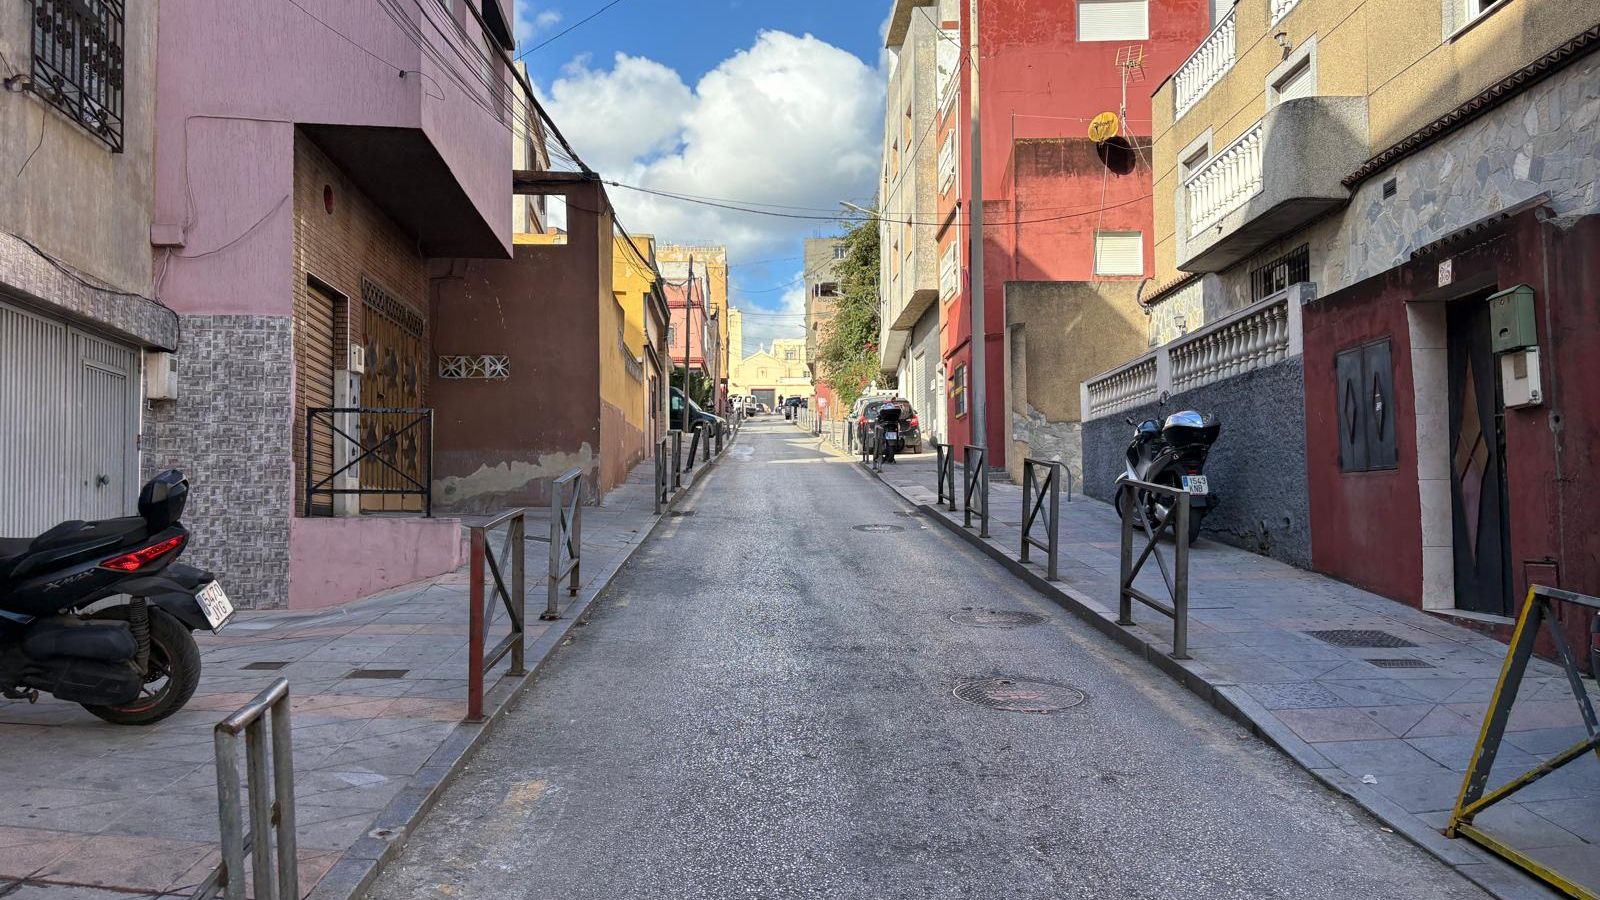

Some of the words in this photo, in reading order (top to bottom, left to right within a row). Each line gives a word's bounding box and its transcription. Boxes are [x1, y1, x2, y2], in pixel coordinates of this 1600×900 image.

[1189, 477, 1206, 485] 1543
[202, 583, 223, 607] 5470
[212, 600, 227, 621] JYG
